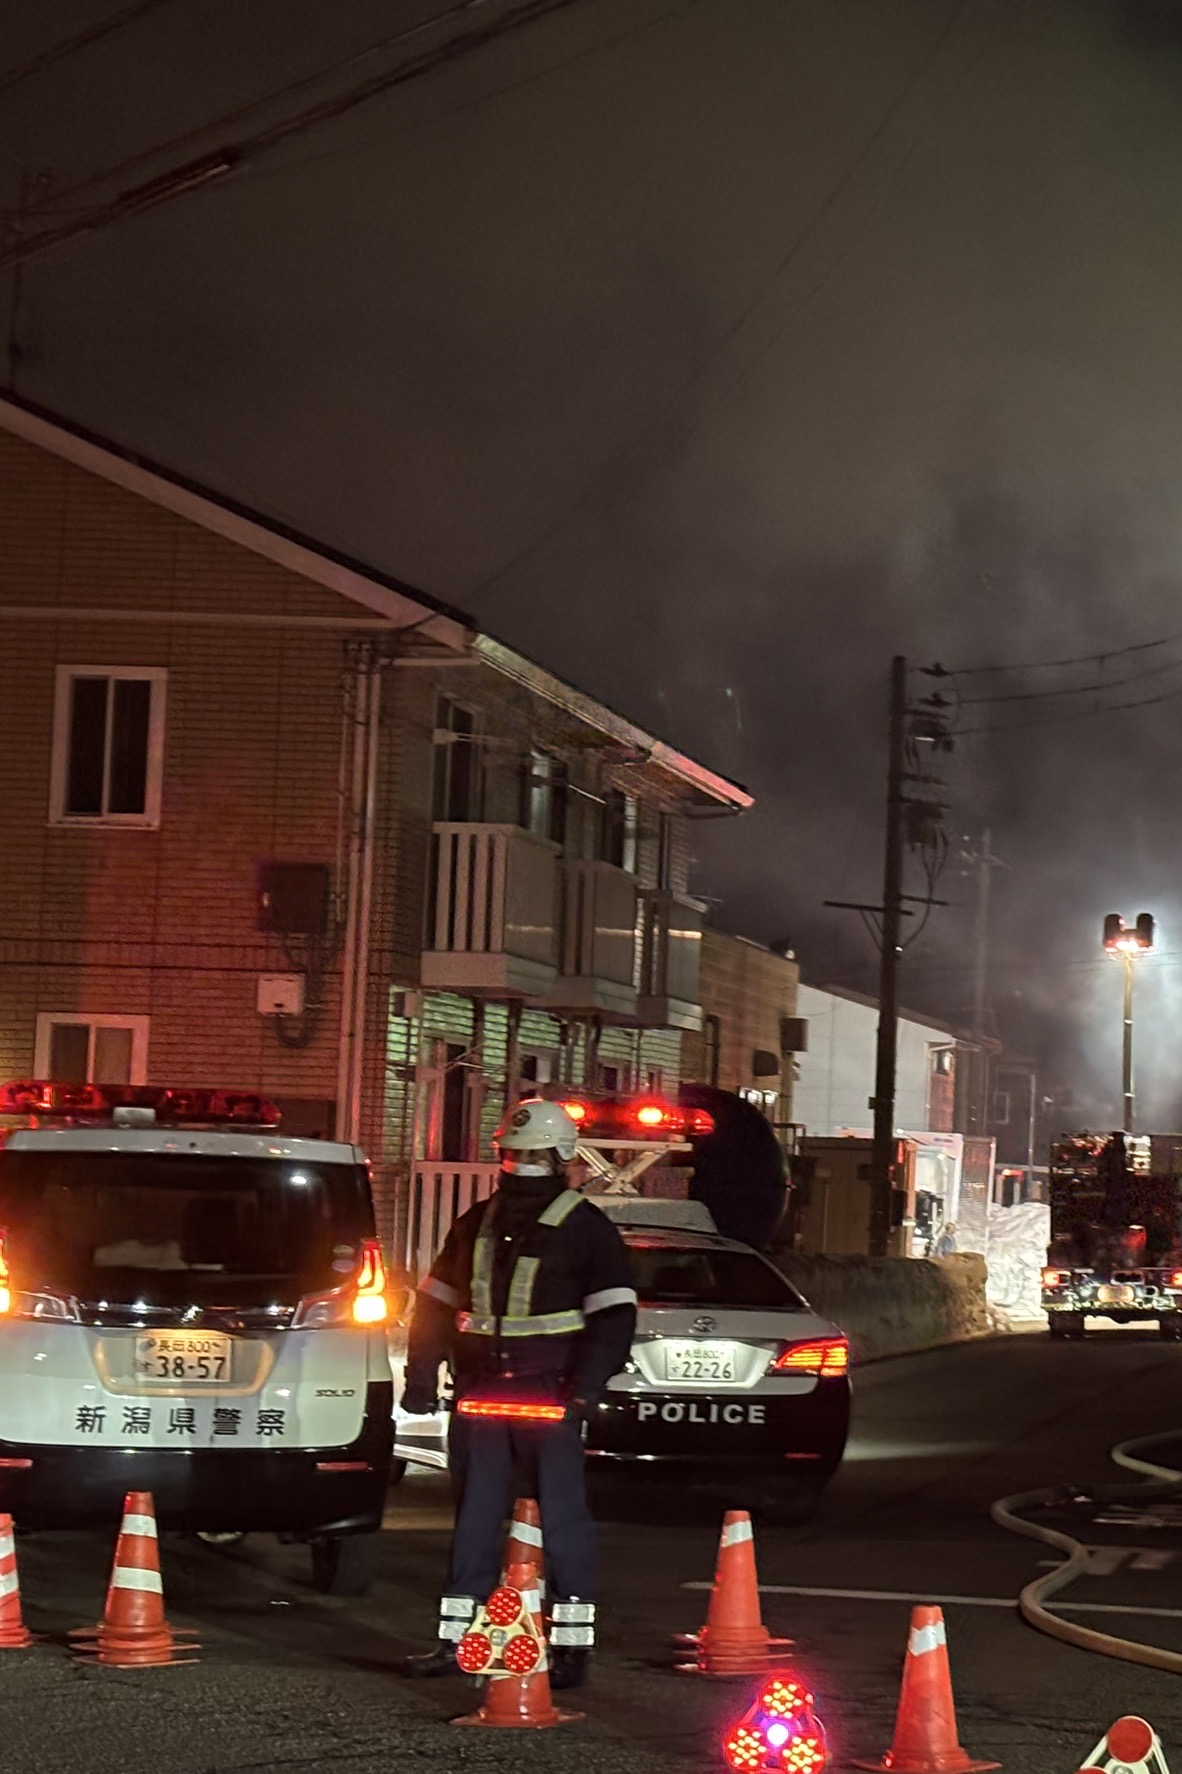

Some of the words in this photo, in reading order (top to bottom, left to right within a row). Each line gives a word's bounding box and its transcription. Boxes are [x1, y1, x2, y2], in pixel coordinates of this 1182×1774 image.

[155, 1355, 227, 1379] 38-57
[682, 1360, 733, 1379] 22-26
[74, 1404, 285, 1436] 新潟県警察
[637, 1401, 766, 1424] POLICE
